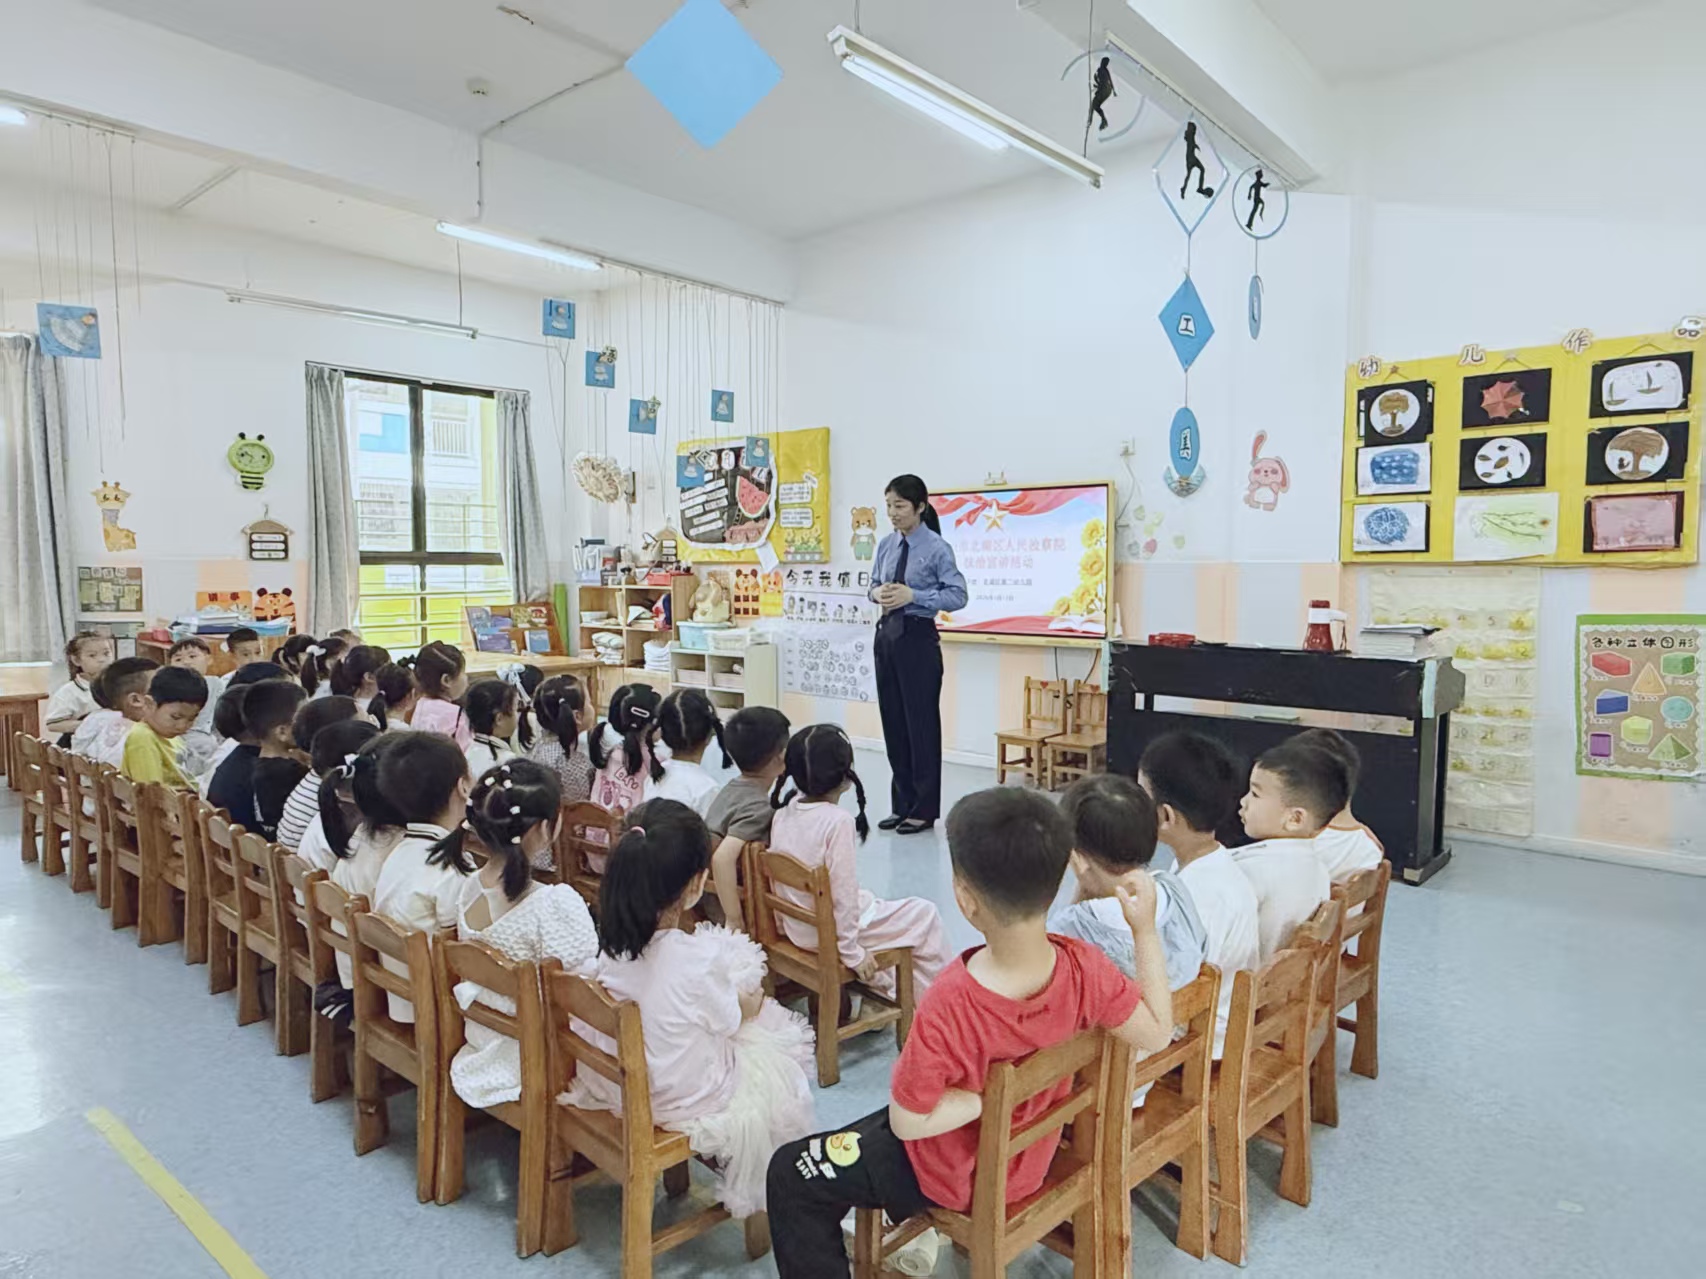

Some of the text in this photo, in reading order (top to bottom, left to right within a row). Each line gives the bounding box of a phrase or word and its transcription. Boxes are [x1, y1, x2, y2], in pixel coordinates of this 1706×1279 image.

[1180, 317, 1194, 334] 工
[786, 568, 869, 588] 今天我值日
[1592, 636, 1695, 649] 各种立体图形
